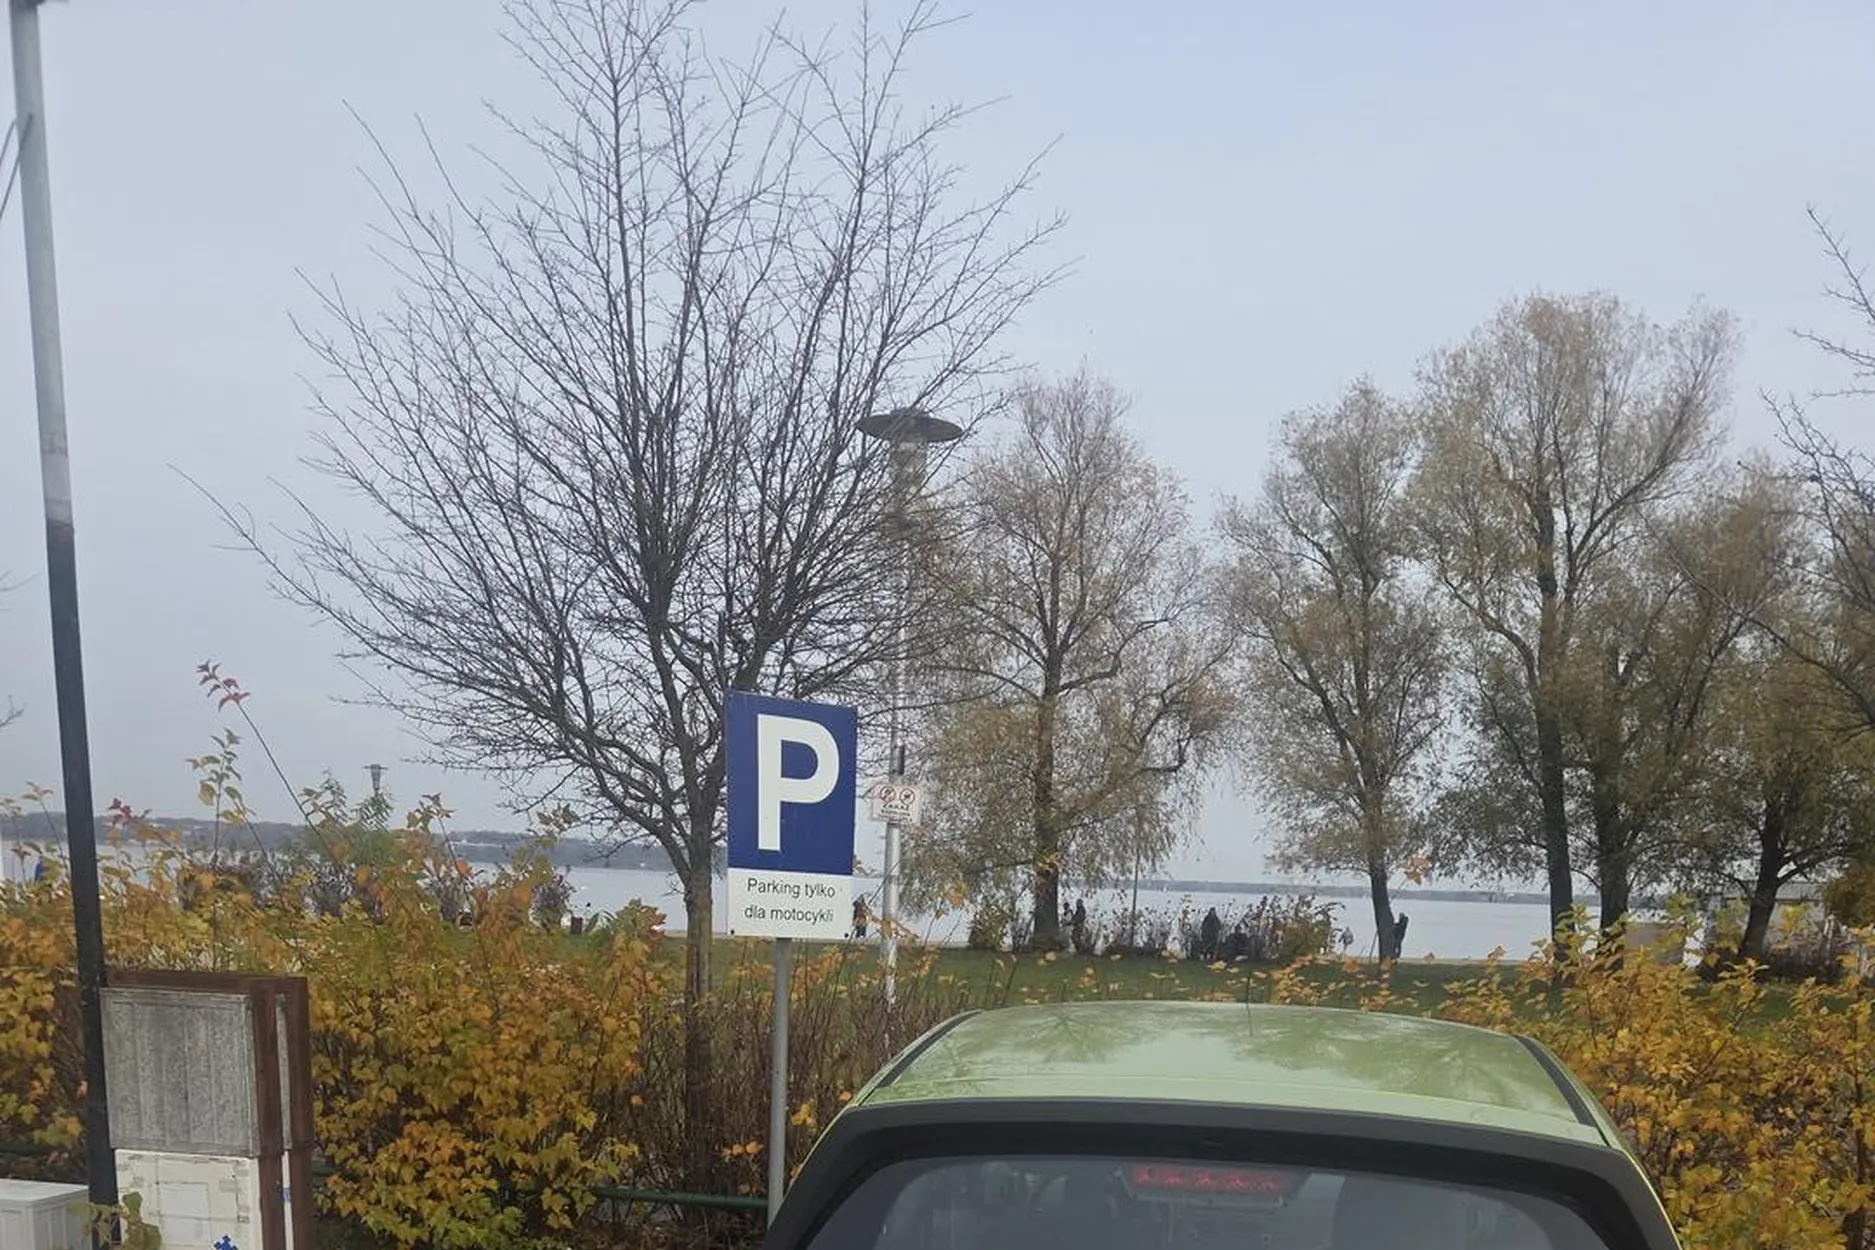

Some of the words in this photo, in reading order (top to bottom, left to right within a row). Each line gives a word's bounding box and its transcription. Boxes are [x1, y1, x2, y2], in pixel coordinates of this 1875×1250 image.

[757, 713, 840, 851] P
[747, 878, 801, 899] Parking
[804, 882, 836, 898] tylko
[744, 905, 766, 919] dla
[770, 908, 834, 925] motocykli
